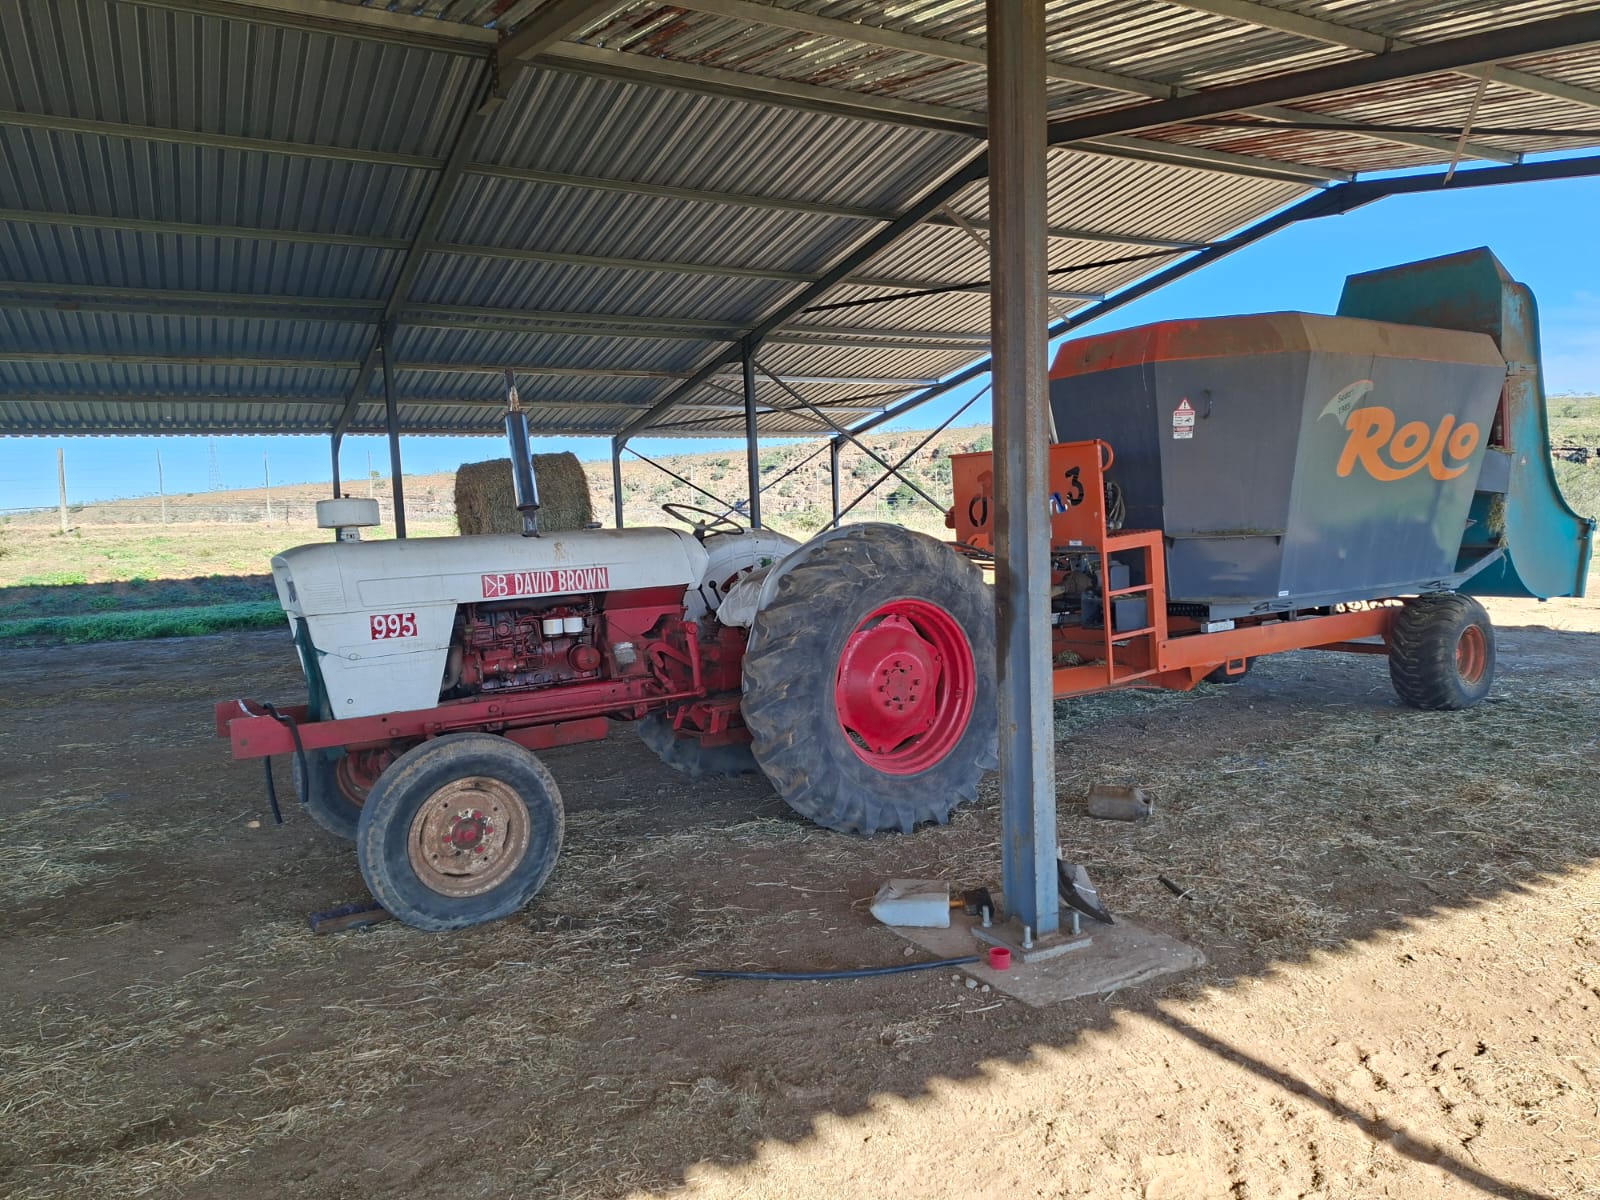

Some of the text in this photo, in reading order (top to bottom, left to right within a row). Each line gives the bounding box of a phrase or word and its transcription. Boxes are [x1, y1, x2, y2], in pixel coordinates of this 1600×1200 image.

[1336, 406, 1480, 482] Rolo
[514, 571, 554, 594] DAVID
[558, 567, 607, 591] BROWN
[373, 613, 415, 639] 995
